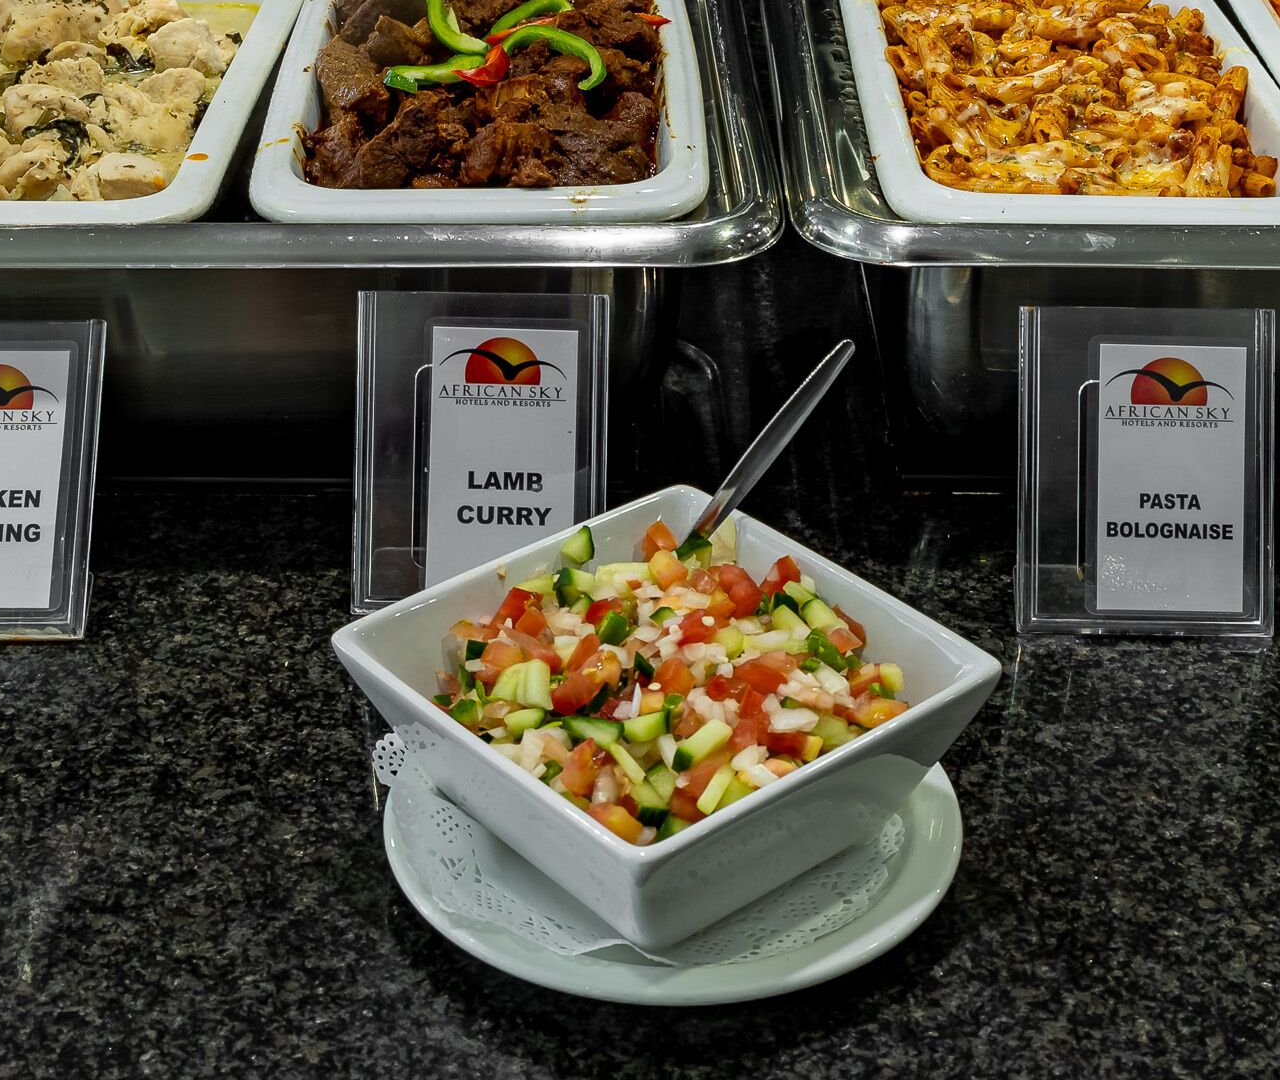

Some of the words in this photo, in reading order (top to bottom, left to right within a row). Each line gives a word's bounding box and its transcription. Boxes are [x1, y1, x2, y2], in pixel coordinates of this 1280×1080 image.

[439, 384, 523, 398] AFRICAN
[529, 386, 563, 399] SKY
[455, 399, 488, 407] HOTELS
[512, 400, 551, 408] RESORTS
[20, 410, 56, 422] SKY
[1105, 405, 1189, 419] AFRICAN
[1195, 407, 1231, 420] SKY
[1157, 420, 1177, 428] AND
[468, 470, 543, 492] LAMB
[1139, 493, 1201, 510] PASTA
[456, 505, 552, 526] CURRY
[1106, 521, 1234, 540] BOLOGNAISE
